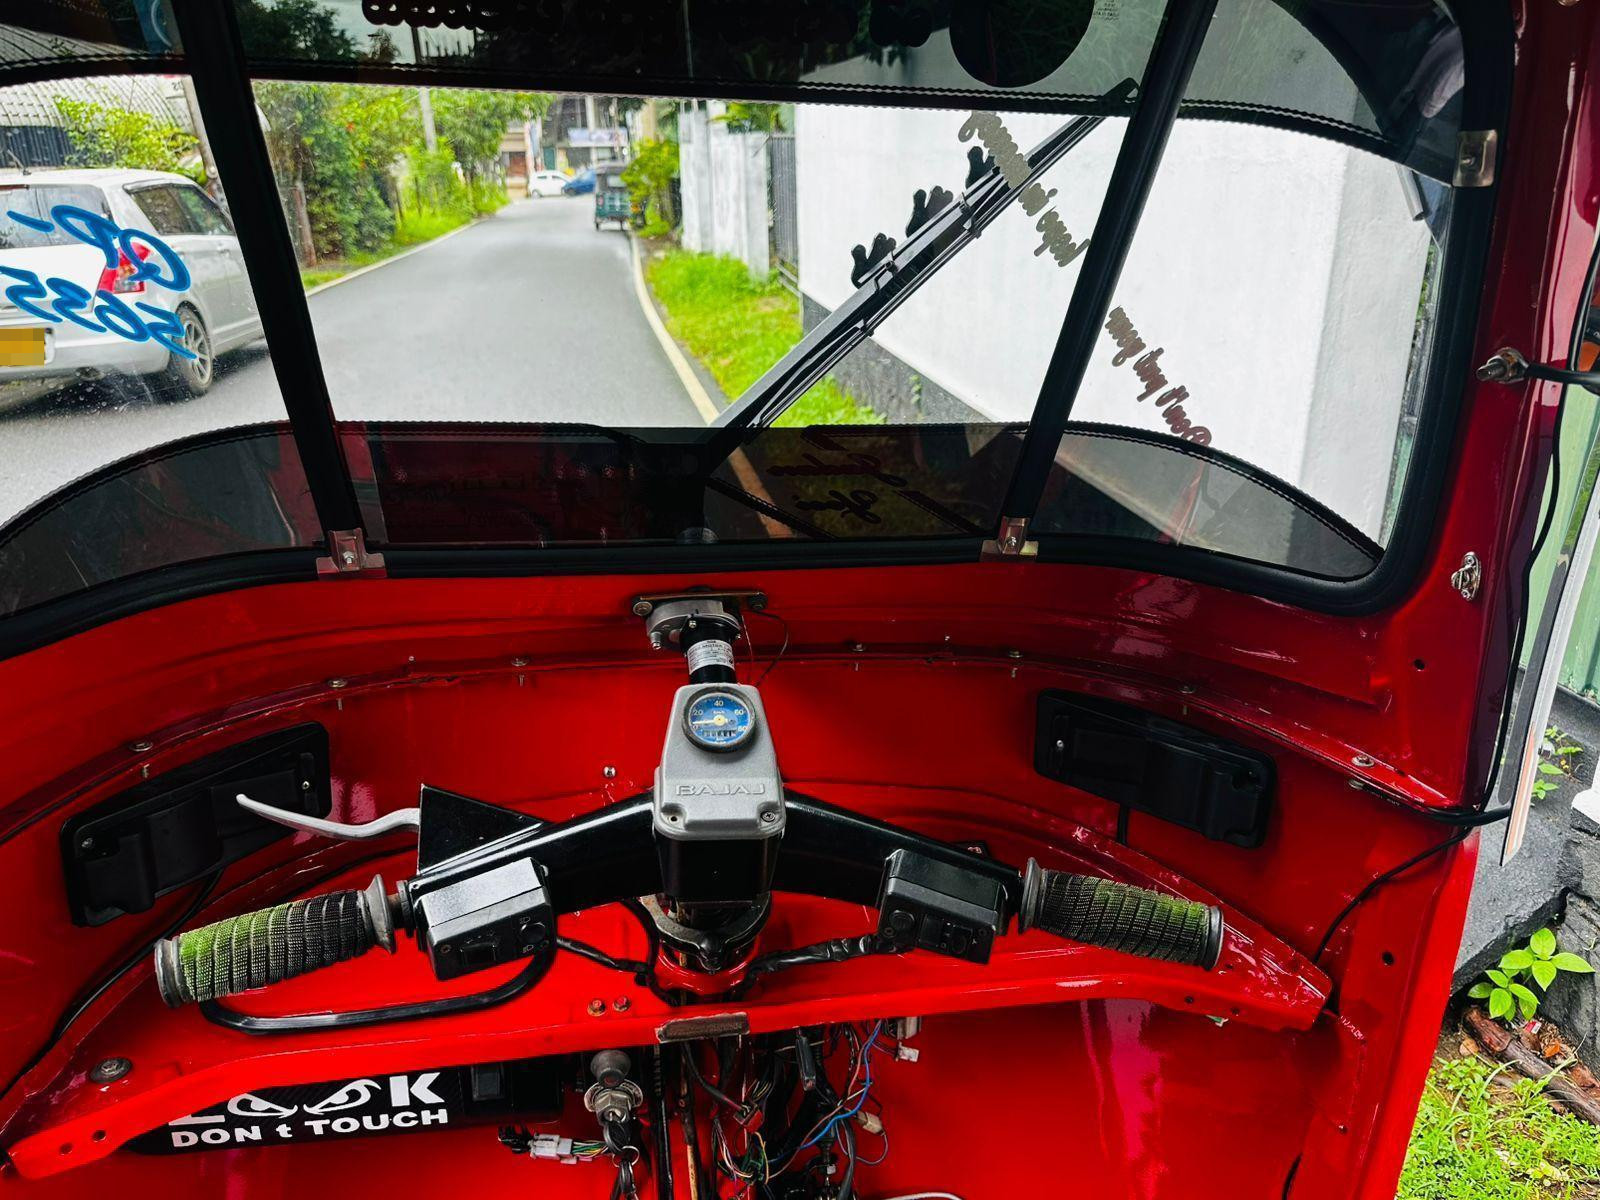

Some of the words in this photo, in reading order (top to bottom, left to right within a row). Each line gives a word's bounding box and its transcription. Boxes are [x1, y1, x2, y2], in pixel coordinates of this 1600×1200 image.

[693, 709, 704, 717] 20
[675, 782, 767, 797] BAJAJ
[170, 1125, 262, 1148] DON
[275, 1122, 293, 1138] t
[304, 1108, 449, 1136] TOUCH
